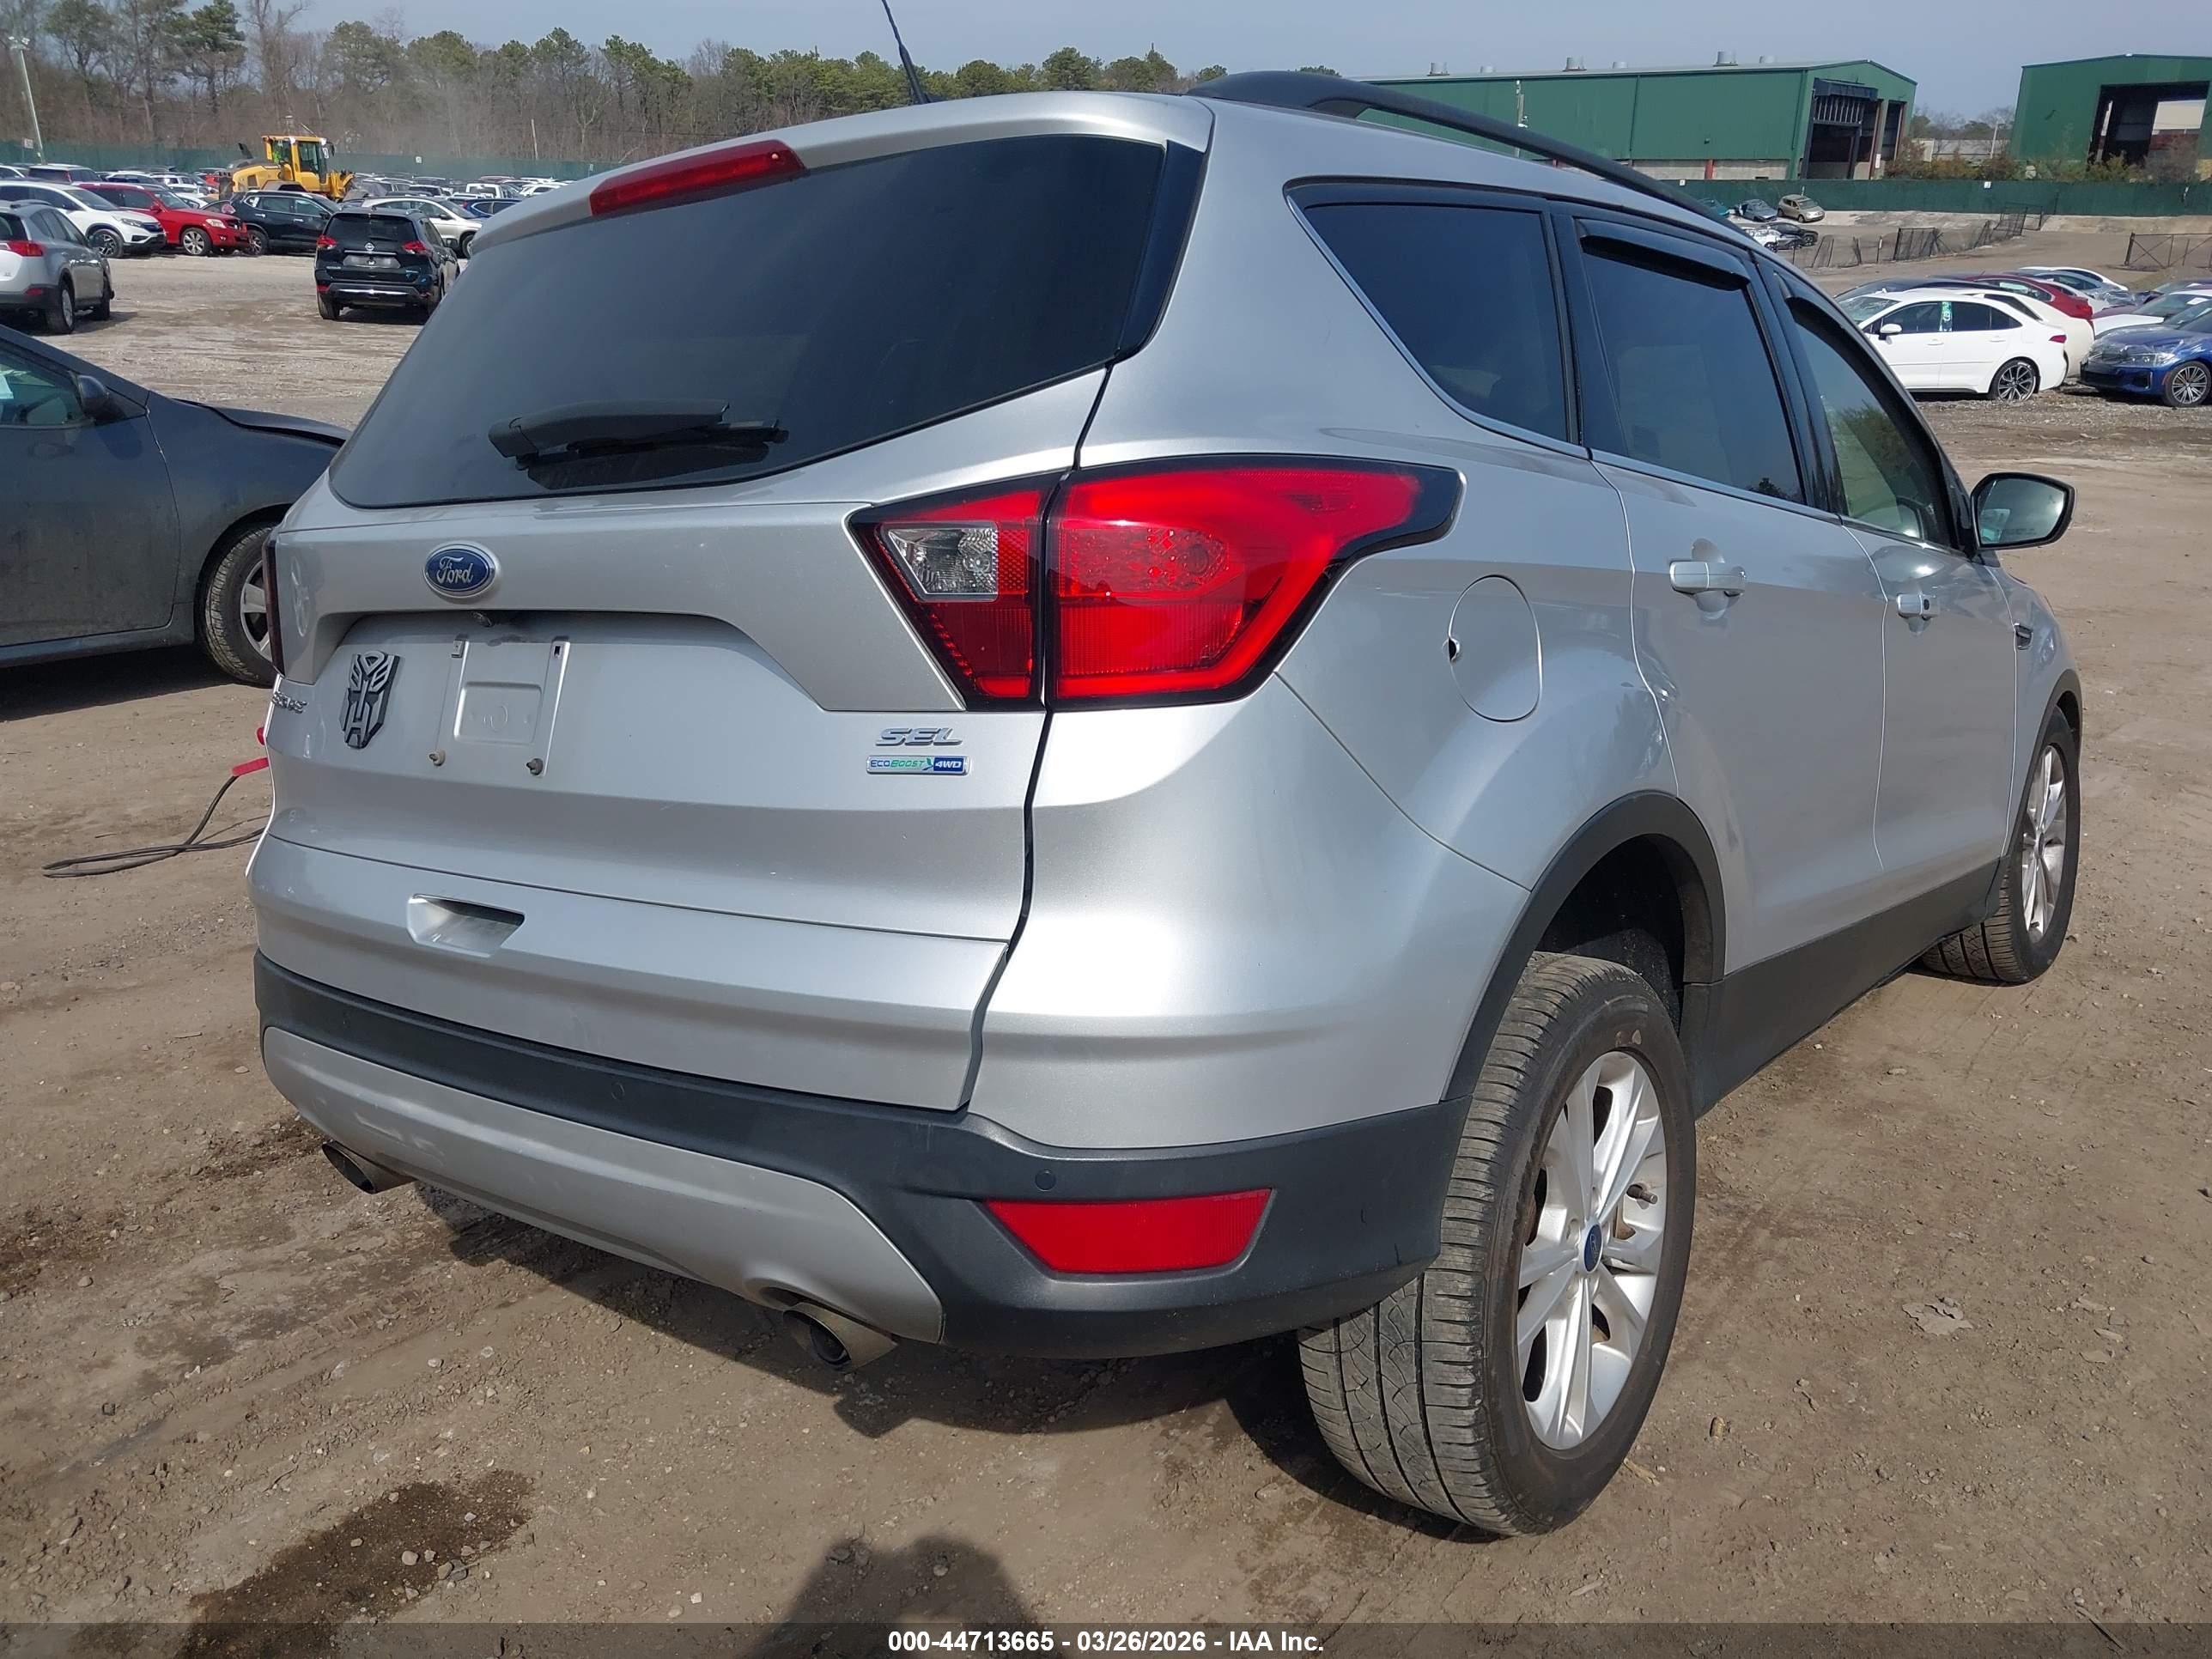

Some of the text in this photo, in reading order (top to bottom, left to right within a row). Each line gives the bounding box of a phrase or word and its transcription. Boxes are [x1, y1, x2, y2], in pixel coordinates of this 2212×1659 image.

[436, 556, 474, 584] Ford
[875, 728, 963, 746] SEL
[935, 760, 963, 769] 4WD
